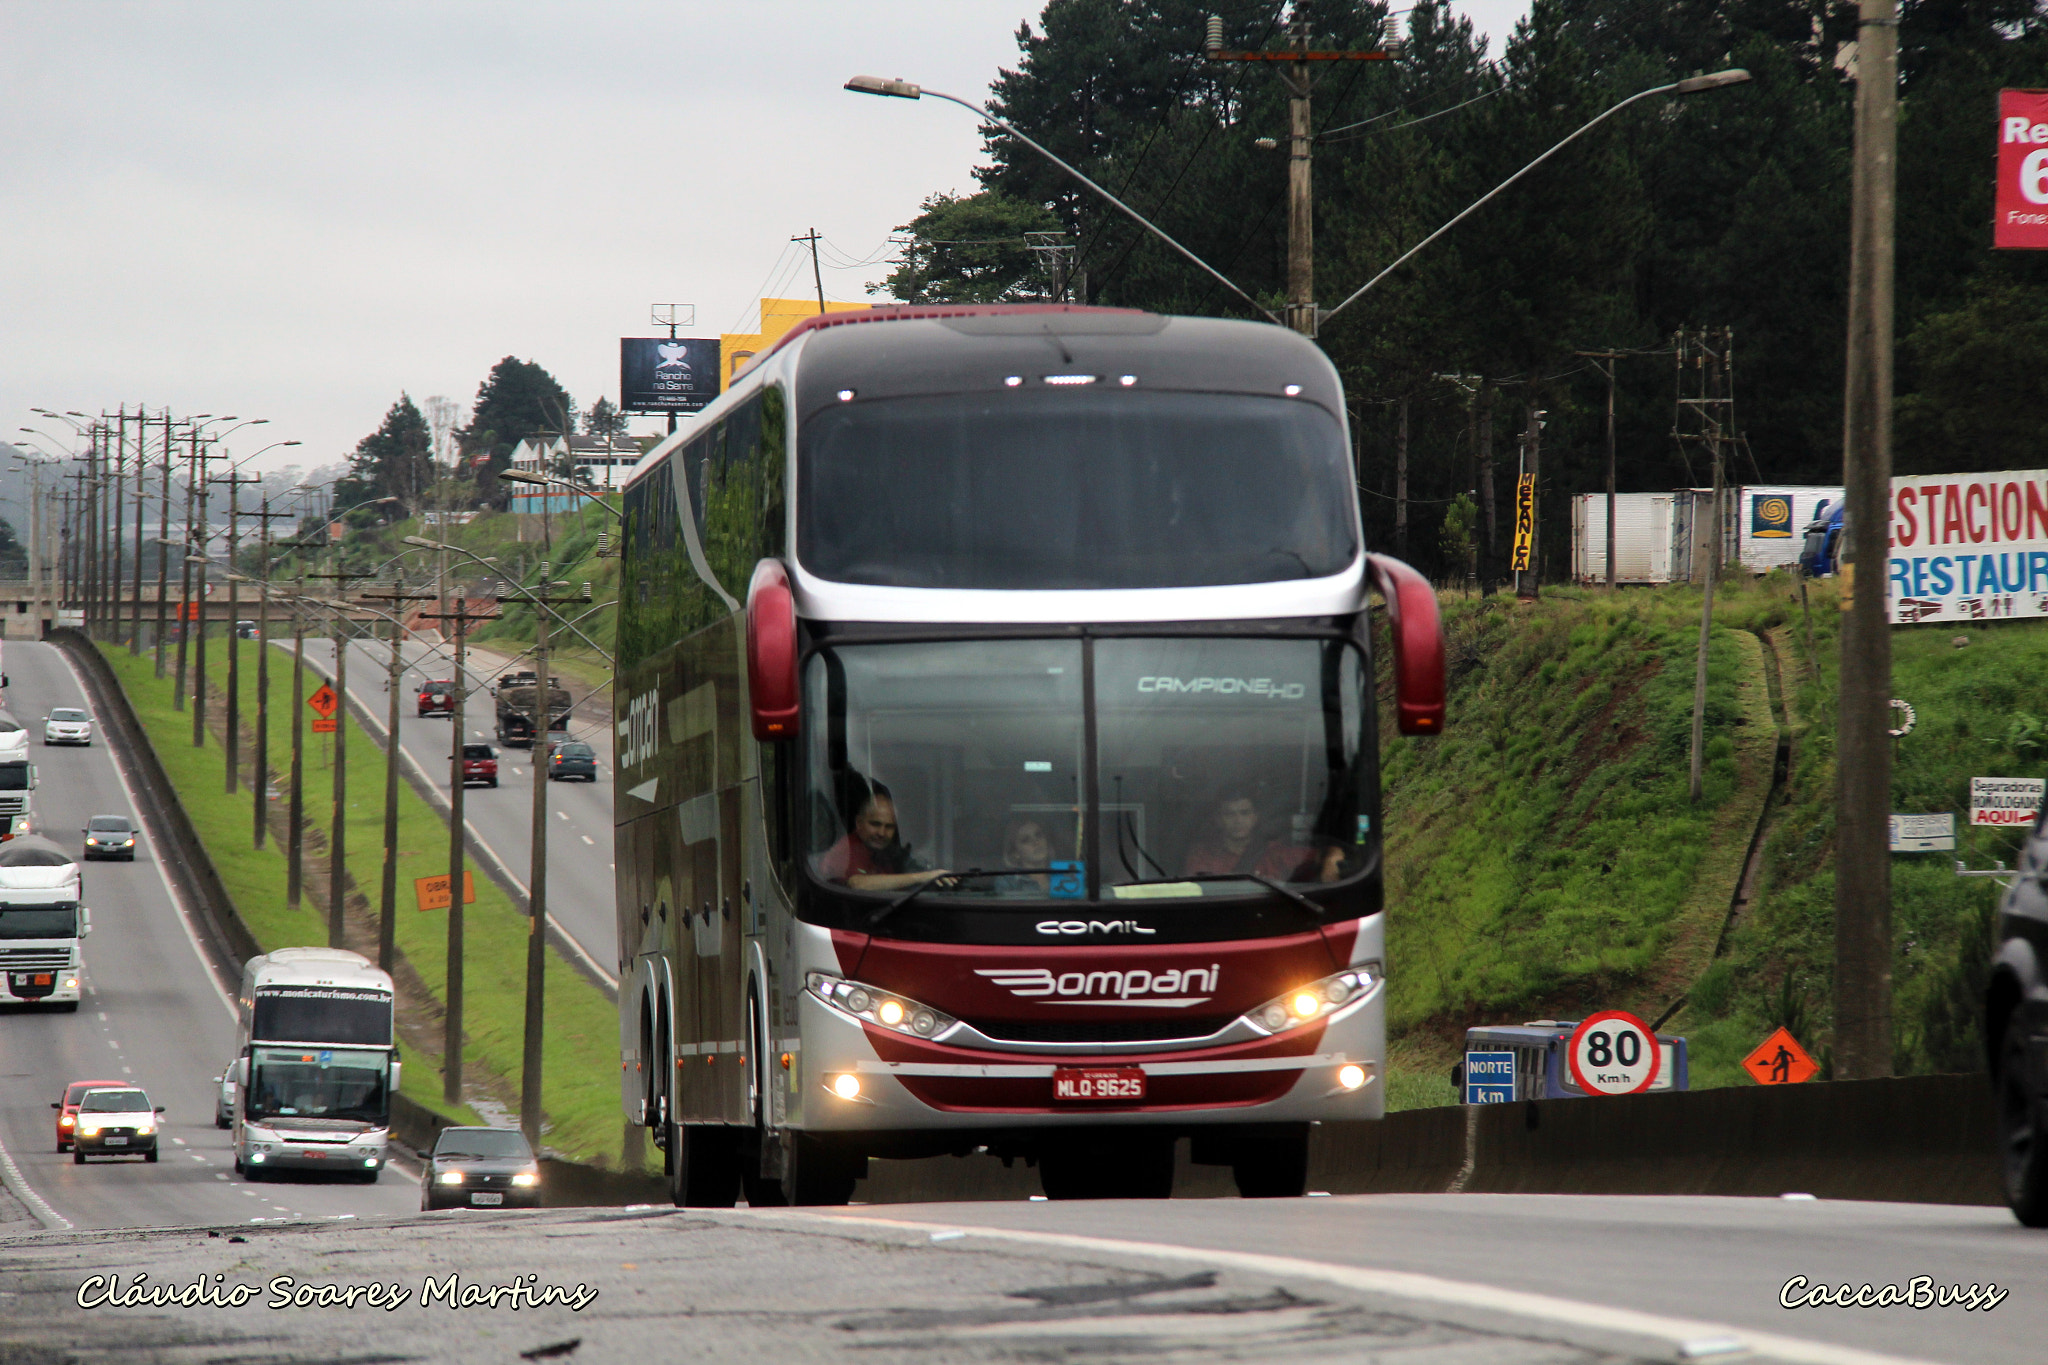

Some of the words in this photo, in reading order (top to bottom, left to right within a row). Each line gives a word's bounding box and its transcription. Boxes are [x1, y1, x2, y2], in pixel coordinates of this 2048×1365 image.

[2004, 117, 2048, 144] Re
[2019, 148, 2048, 205] 6
[655, 371, 692, 380] Rancho
[653, 382, 665, 390] na
[666, 381, 694, 390] Serra
[1889, 551, 2048, 597] RESTAUR
[1137, 676, 1272, 694] CAMPIONE
[1267, 683, 1306, 699] HD
[1975, 780, 2043, 795] Seguradoras
[1976, 810, 2019, 824] AQUI
[1035, 921, 1156, 934] COMIL
[973, 963, 1220, 1000] Bompani
[255, 989, 393, 1003] www.monicaturismo.com.br
[1587, 1030, 1640, 1067] 80
[1469, 1060, 1512, 1075] NORTE
[1477, 1088, 1505, 1103] km
